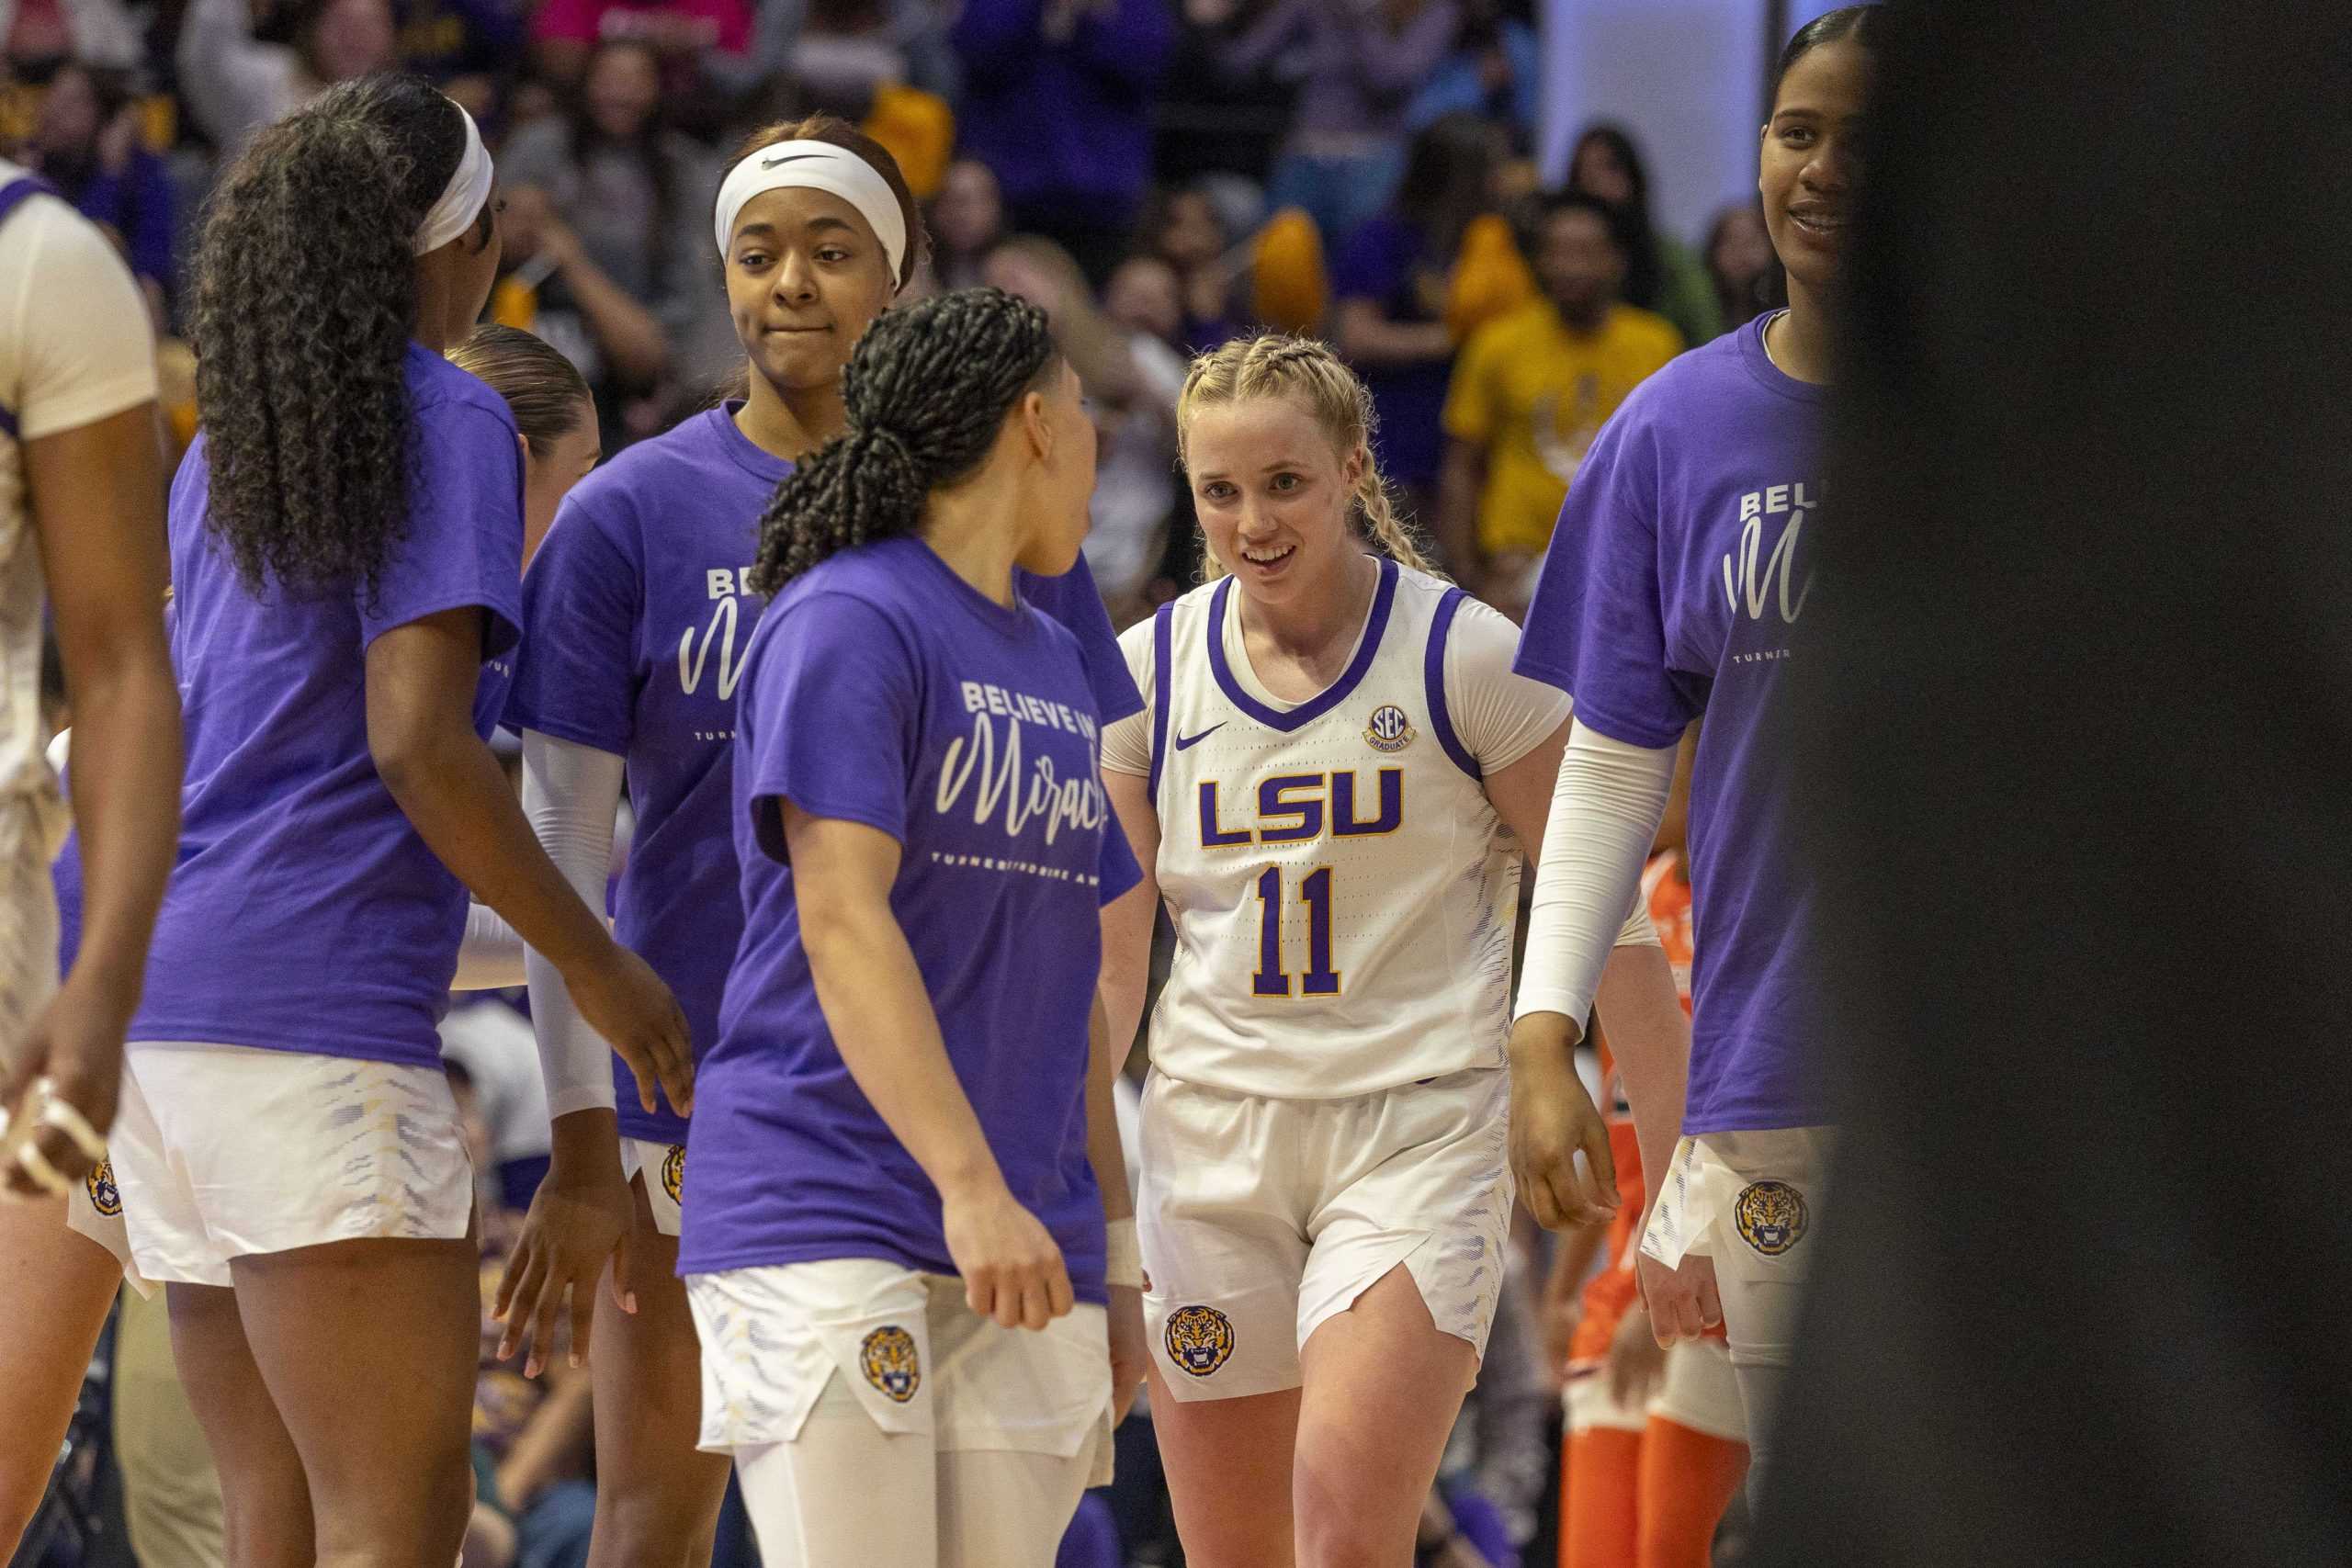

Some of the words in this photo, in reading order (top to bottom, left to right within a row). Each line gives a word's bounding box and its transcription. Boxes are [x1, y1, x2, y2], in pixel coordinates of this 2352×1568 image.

[961, 681, 1078, 734] BELIEVE
[1073, 710, 1097, 741] IN
[1373, 708, 1404, 739] SEC
[1369, 736, 1409, 750] GRADUATE
[1199, 767, 1404, 849] LSU
[1250, 862, 1342, 998] 11
